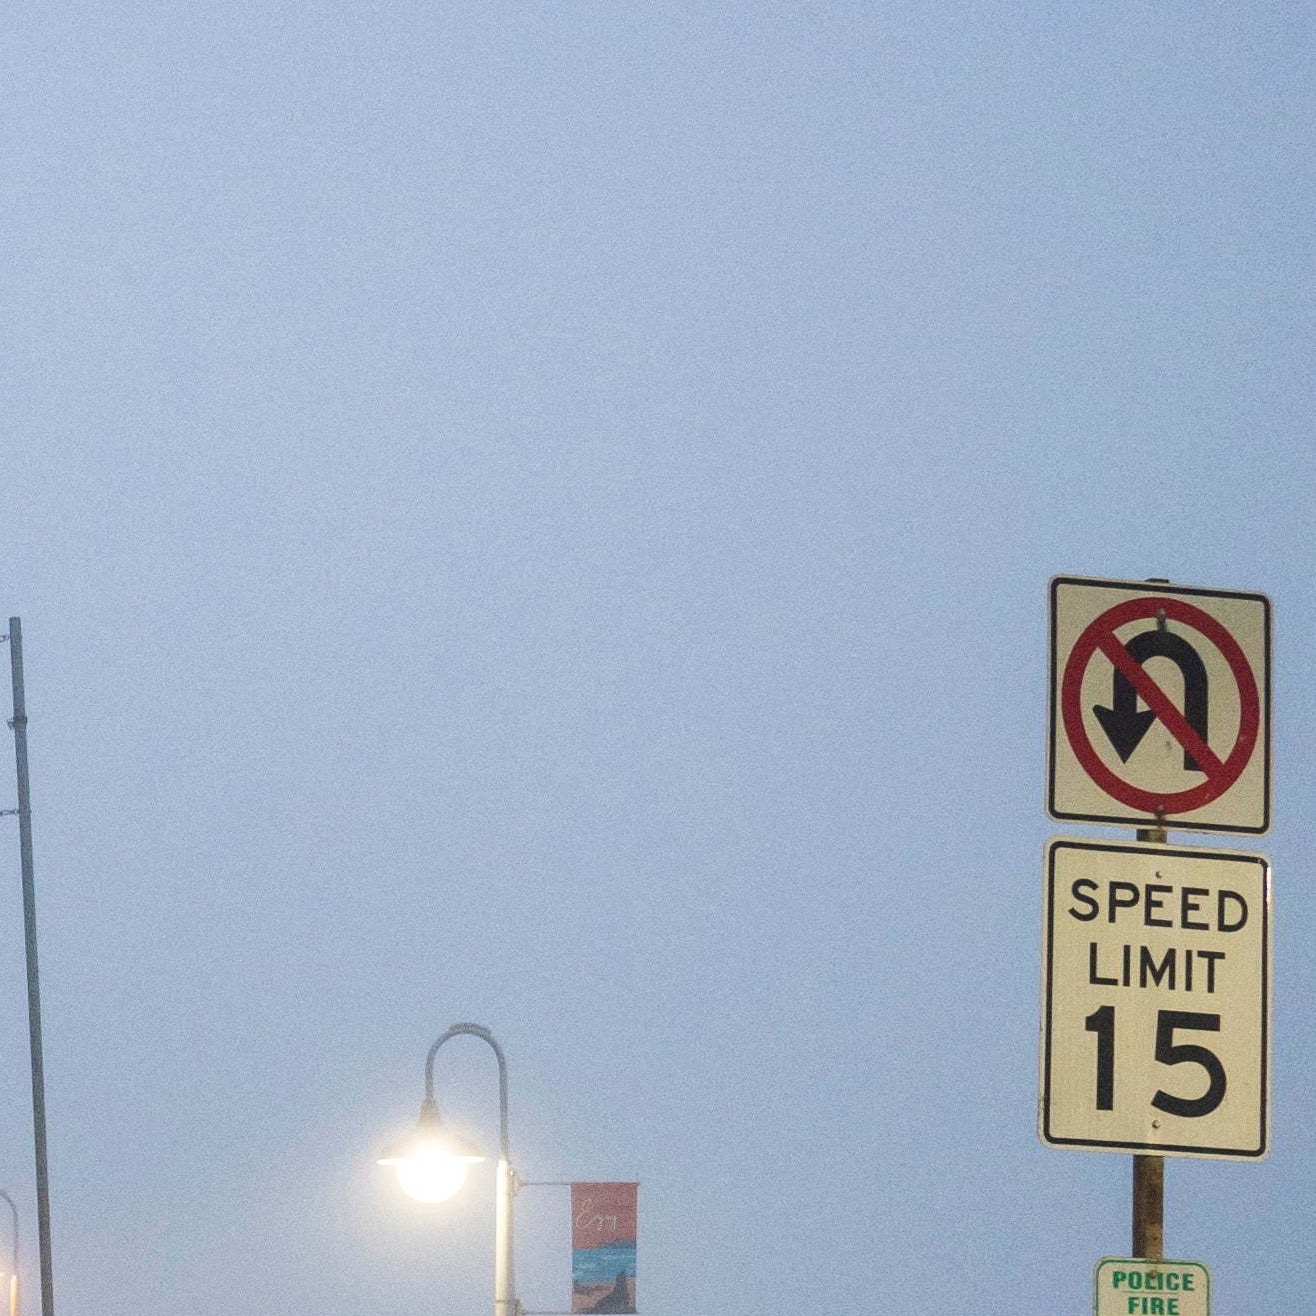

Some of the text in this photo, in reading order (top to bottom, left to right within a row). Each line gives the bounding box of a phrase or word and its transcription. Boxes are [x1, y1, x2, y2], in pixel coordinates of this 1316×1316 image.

[1068, 878, 1248, 932] SPEED
[1089, 942, 1226, 993] LIMIT
[1085, 1005, 1227, 1118] 15
[1112, 1270, 1195, 1291] POLICE
[1128, 1297, 1180, 1315] FIRE
